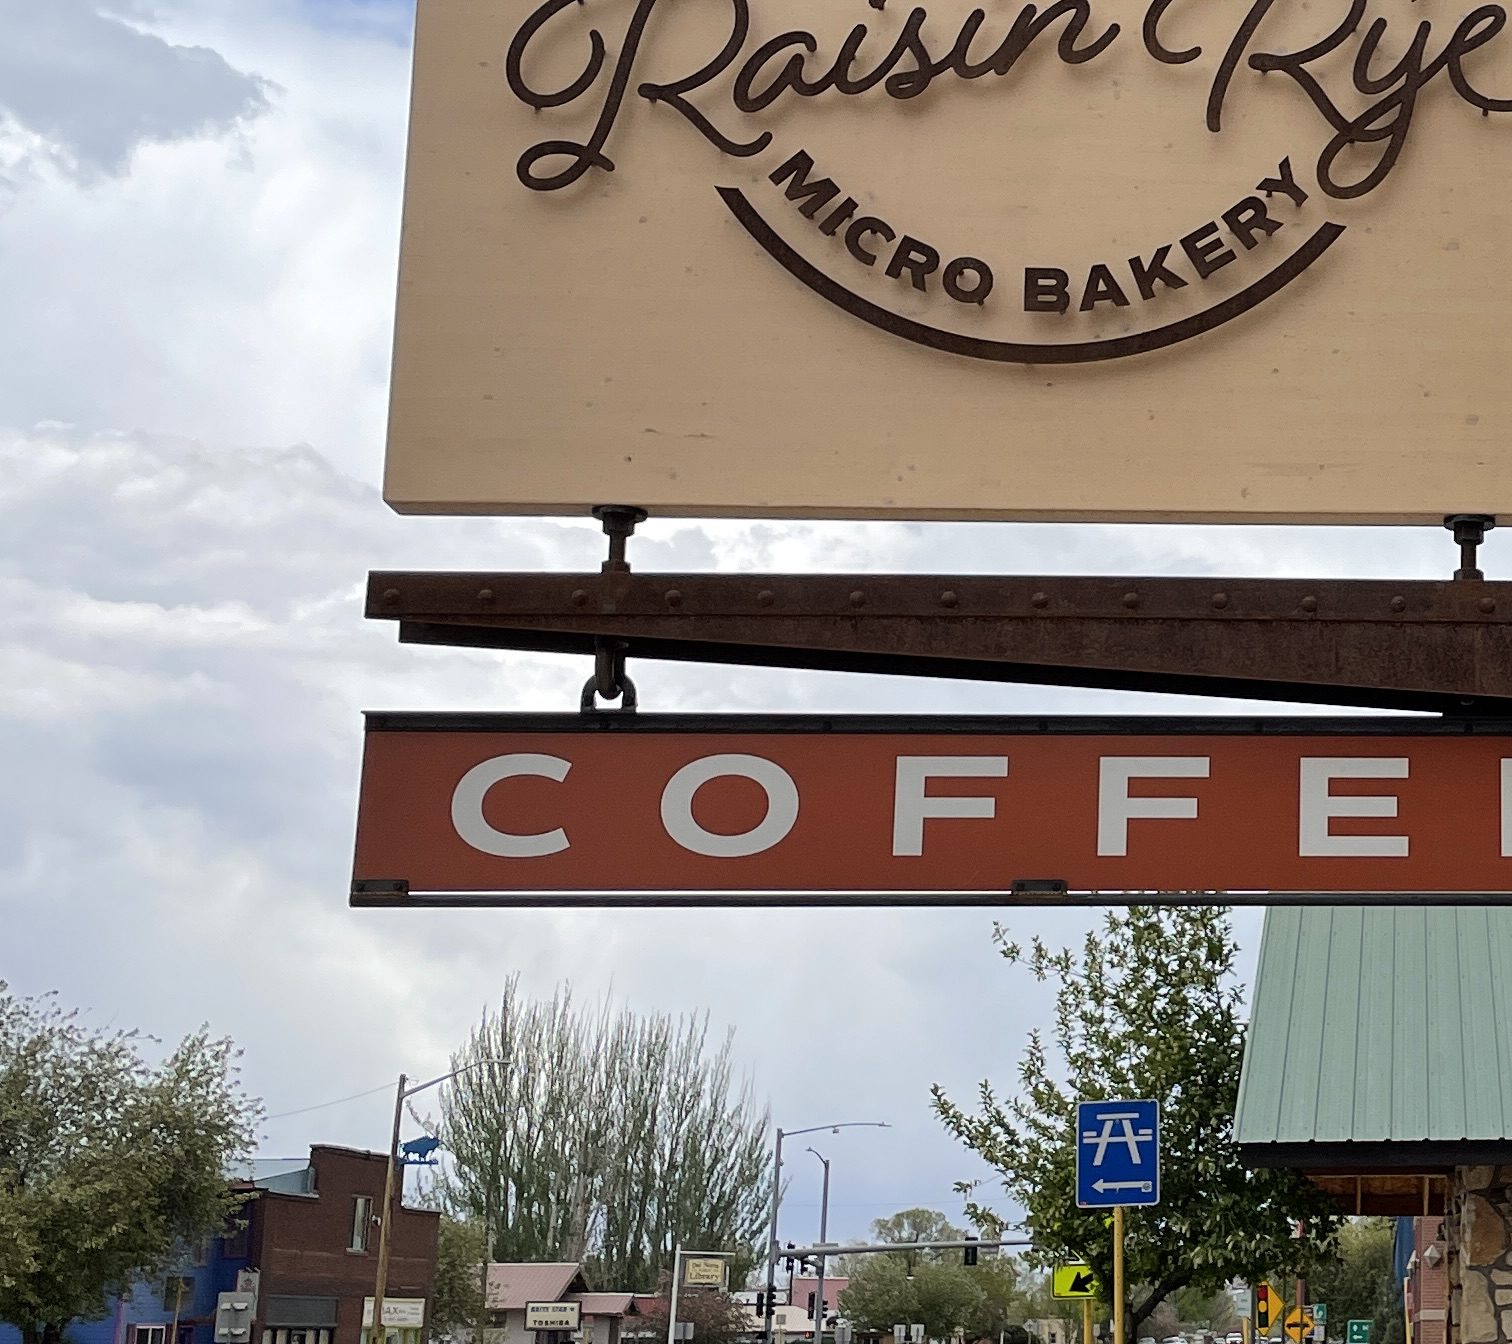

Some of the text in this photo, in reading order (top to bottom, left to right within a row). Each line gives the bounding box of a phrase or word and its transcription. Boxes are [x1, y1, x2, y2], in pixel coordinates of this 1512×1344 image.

[767, 149, 1310, 313] MICRO BAKERY
[532, 1319, 571, 1327] TOSHIBA
